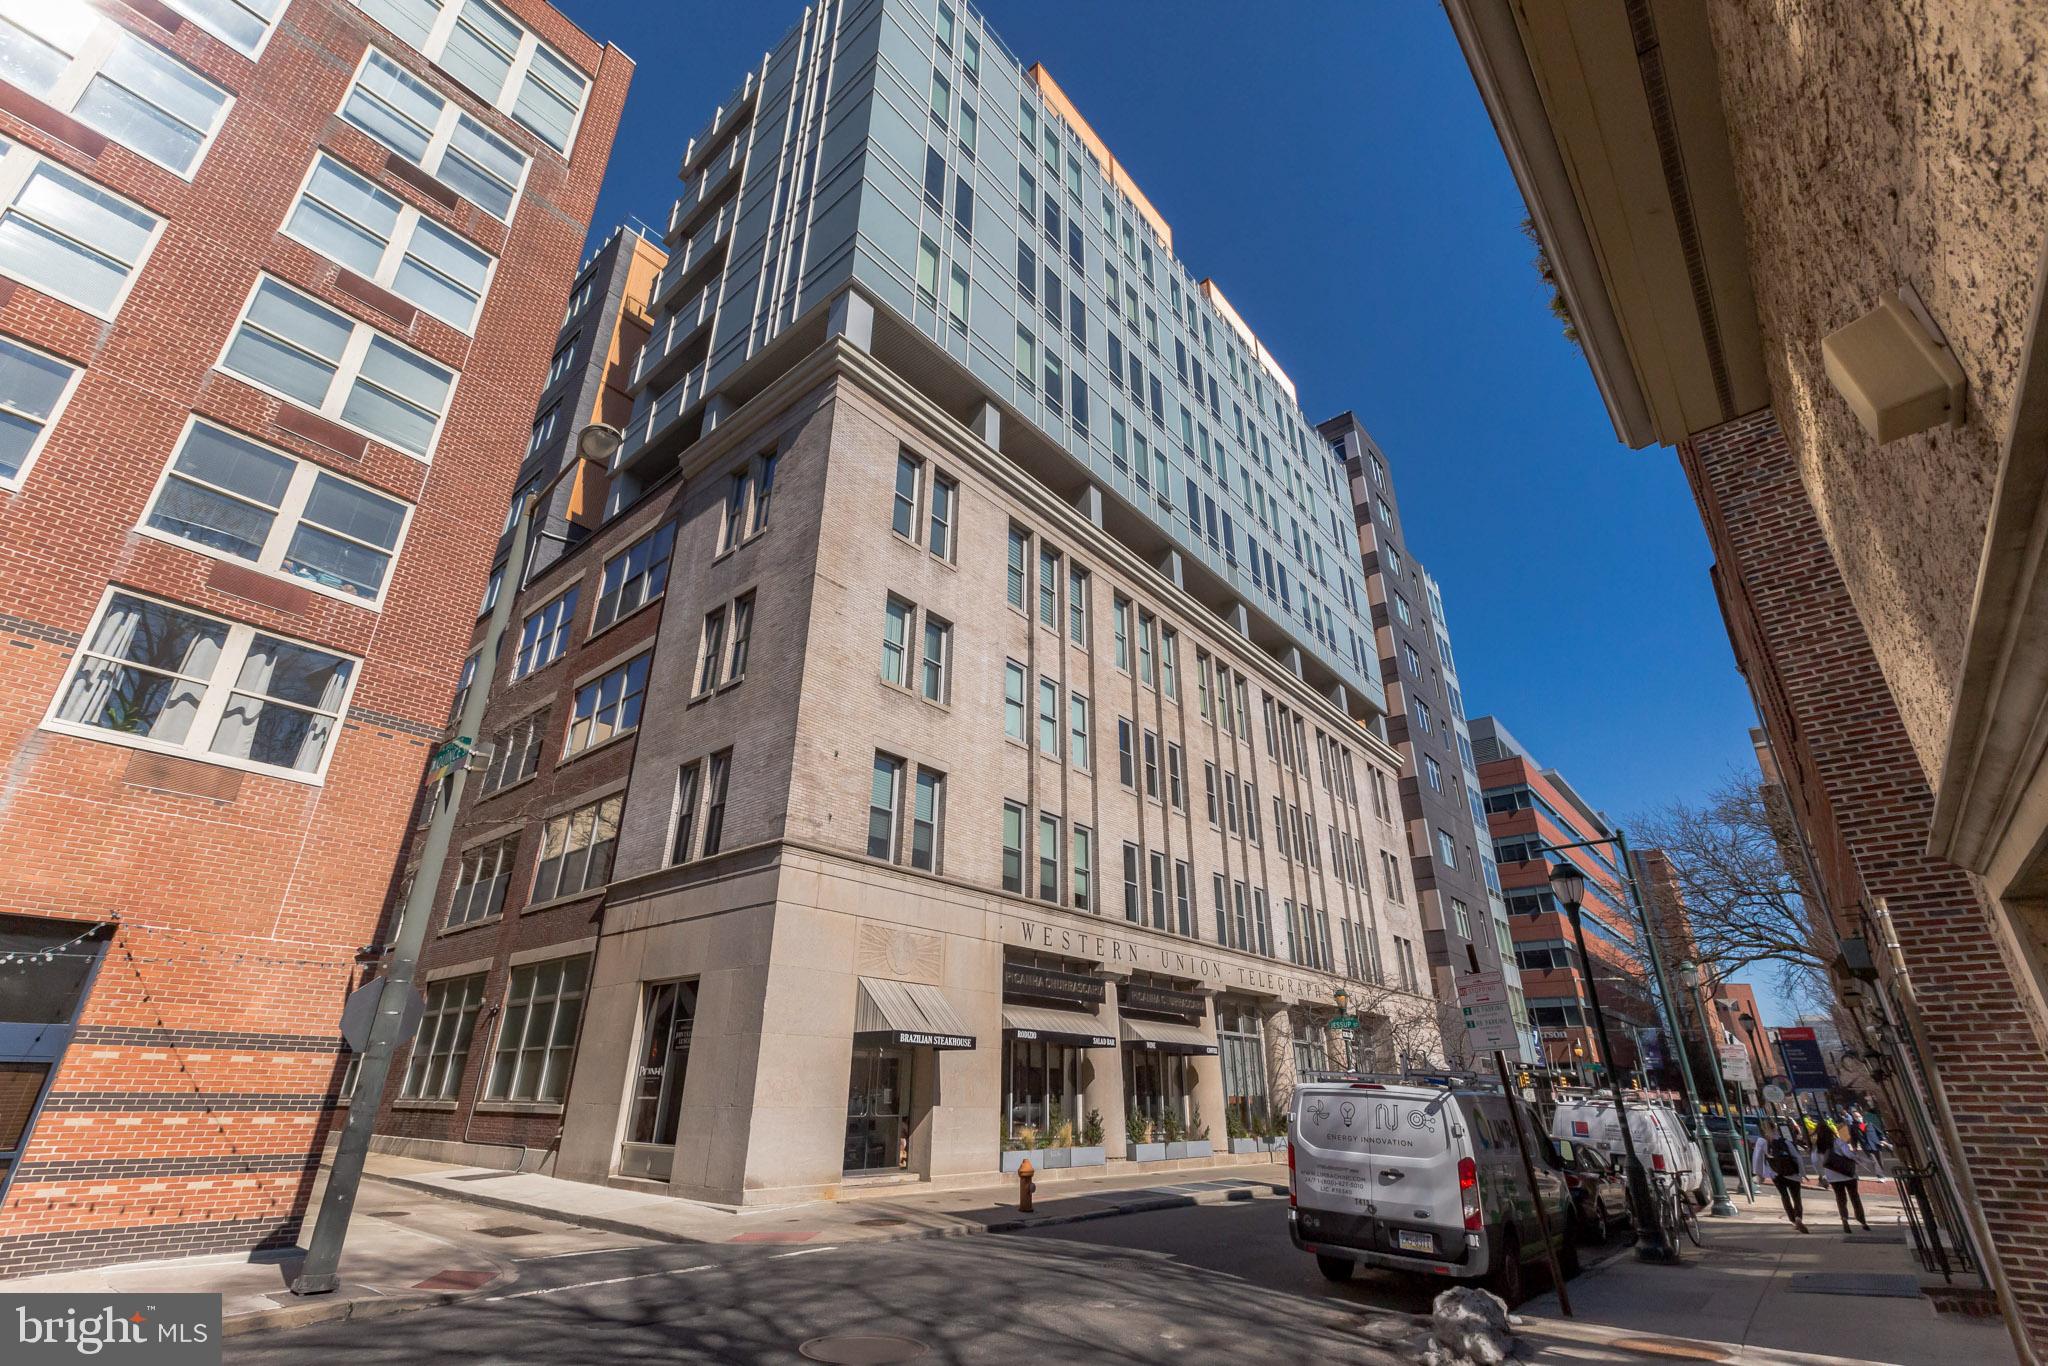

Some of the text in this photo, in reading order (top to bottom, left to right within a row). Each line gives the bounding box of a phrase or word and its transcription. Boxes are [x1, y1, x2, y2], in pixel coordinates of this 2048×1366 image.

[1022, 921, 1321, 998] WESTERN UNION TELEGRAPH
[900, 1033, 972, 1048] BRAZILIAN STEAKHOUSE
[1092, 1037, 1107, 1046] SALAD
[1327, 1133, 1414, 1147] ENERGY INNOVATION
